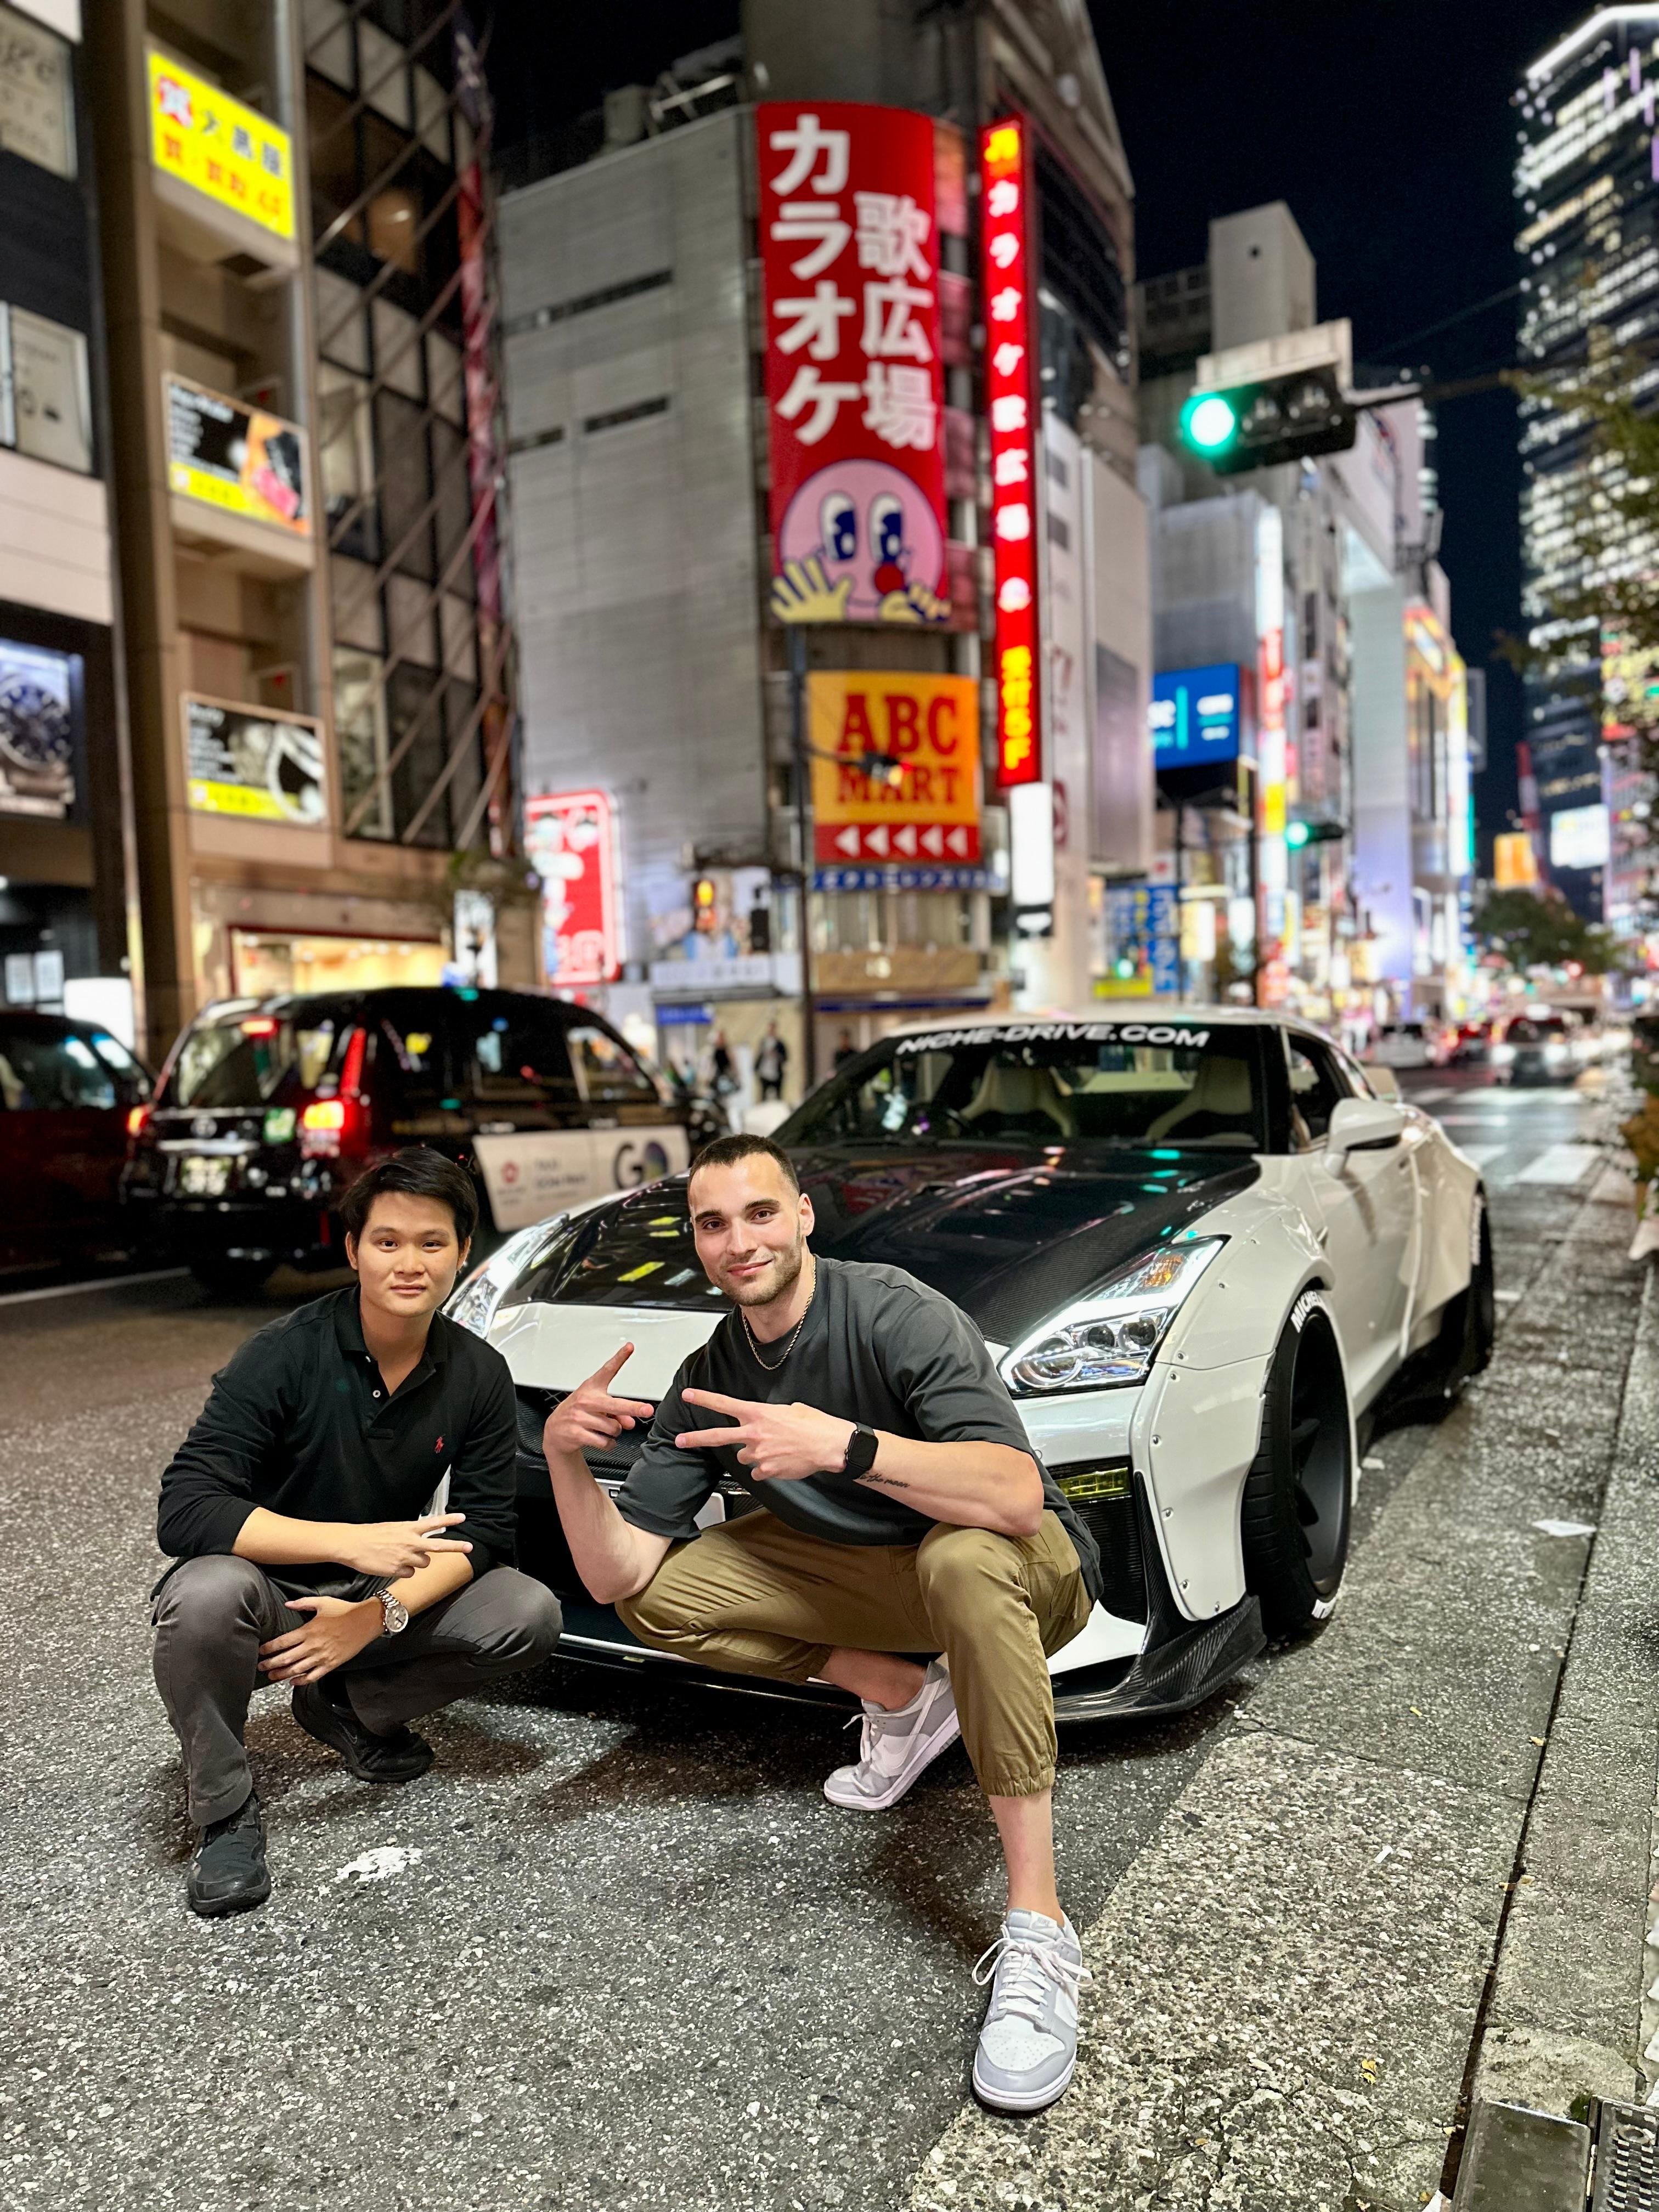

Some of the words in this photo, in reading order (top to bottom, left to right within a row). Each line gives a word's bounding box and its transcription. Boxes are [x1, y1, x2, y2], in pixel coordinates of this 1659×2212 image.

[769, 113, 861, 446] カラオケ
[853, 190, 937, 452] 歌広場
[837, 695, 958, 759] ABC
[896, 1024, 1210, 1055] NICHE-DRIVE.COM
